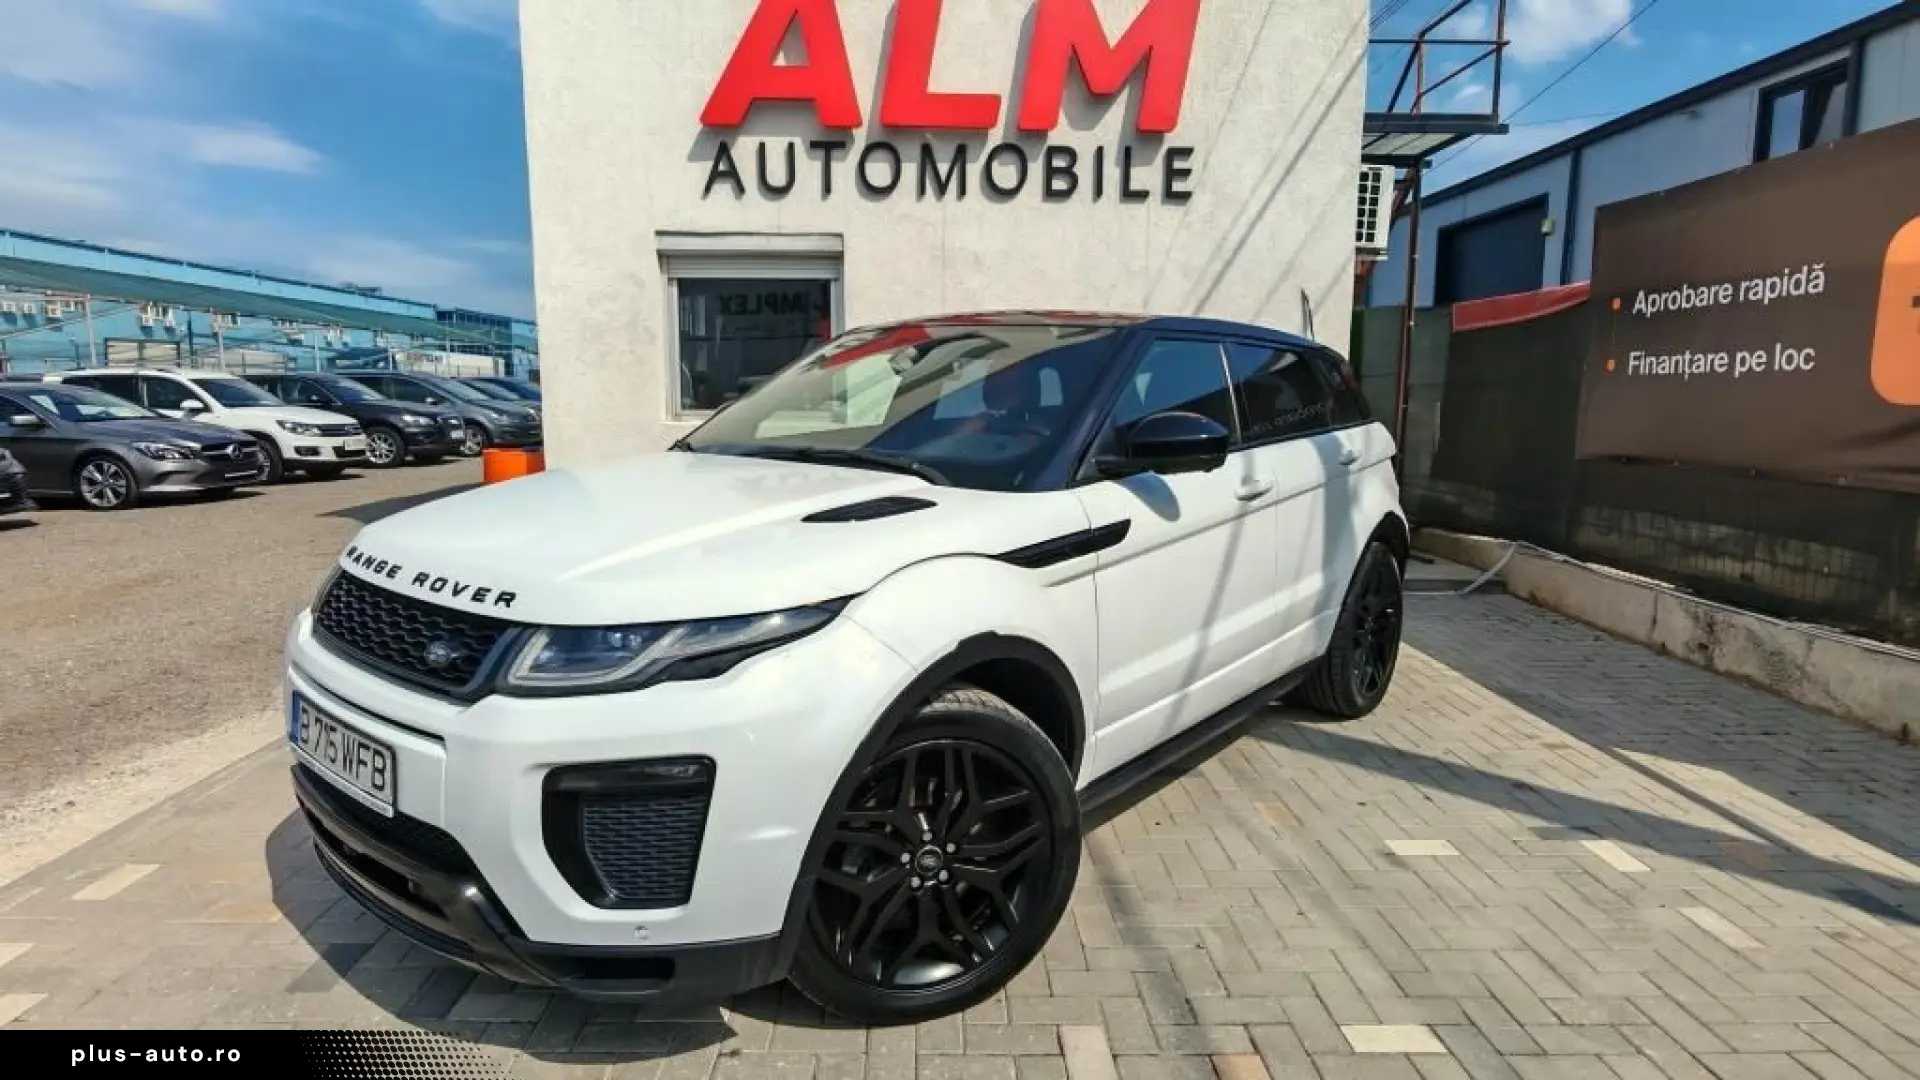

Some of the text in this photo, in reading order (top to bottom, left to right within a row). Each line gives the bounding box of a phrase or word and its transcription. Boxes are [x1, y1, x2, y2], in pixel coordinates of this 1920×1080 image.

[700, 0, 1200, 133] ALM
[703, 140, 1195, 201] AUTOMOBILE
[1632, 262, 1826, 318] Aprobare rapidă
[1628, 343, 1816, 381] Finanțare pe loc
[346, 545, 517, 608] RANGE ROVER
[314, 716, 338, 764] 715
[341, 733, 387, 791] WFB
